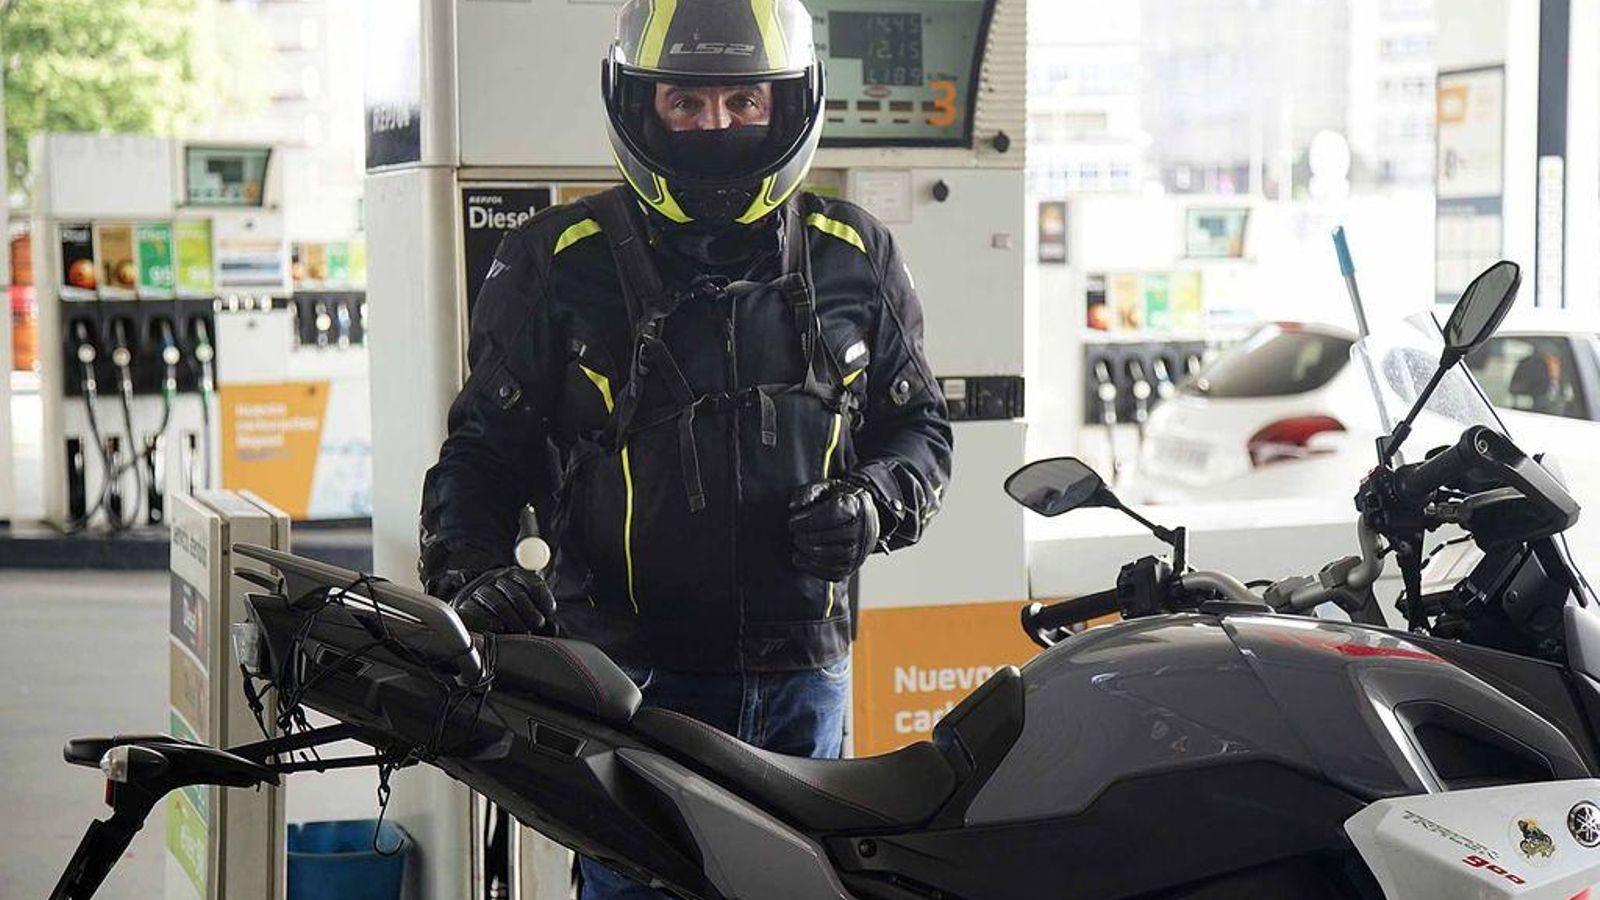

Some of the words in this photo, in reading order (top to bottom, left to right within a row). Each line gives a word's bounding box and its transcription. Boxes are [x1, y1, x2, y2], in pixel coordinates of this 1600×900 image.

[669, 43, 755, 56] LS2
[928, 80, 956, 126] 3
[1462, 855, 1527, 885] 900
